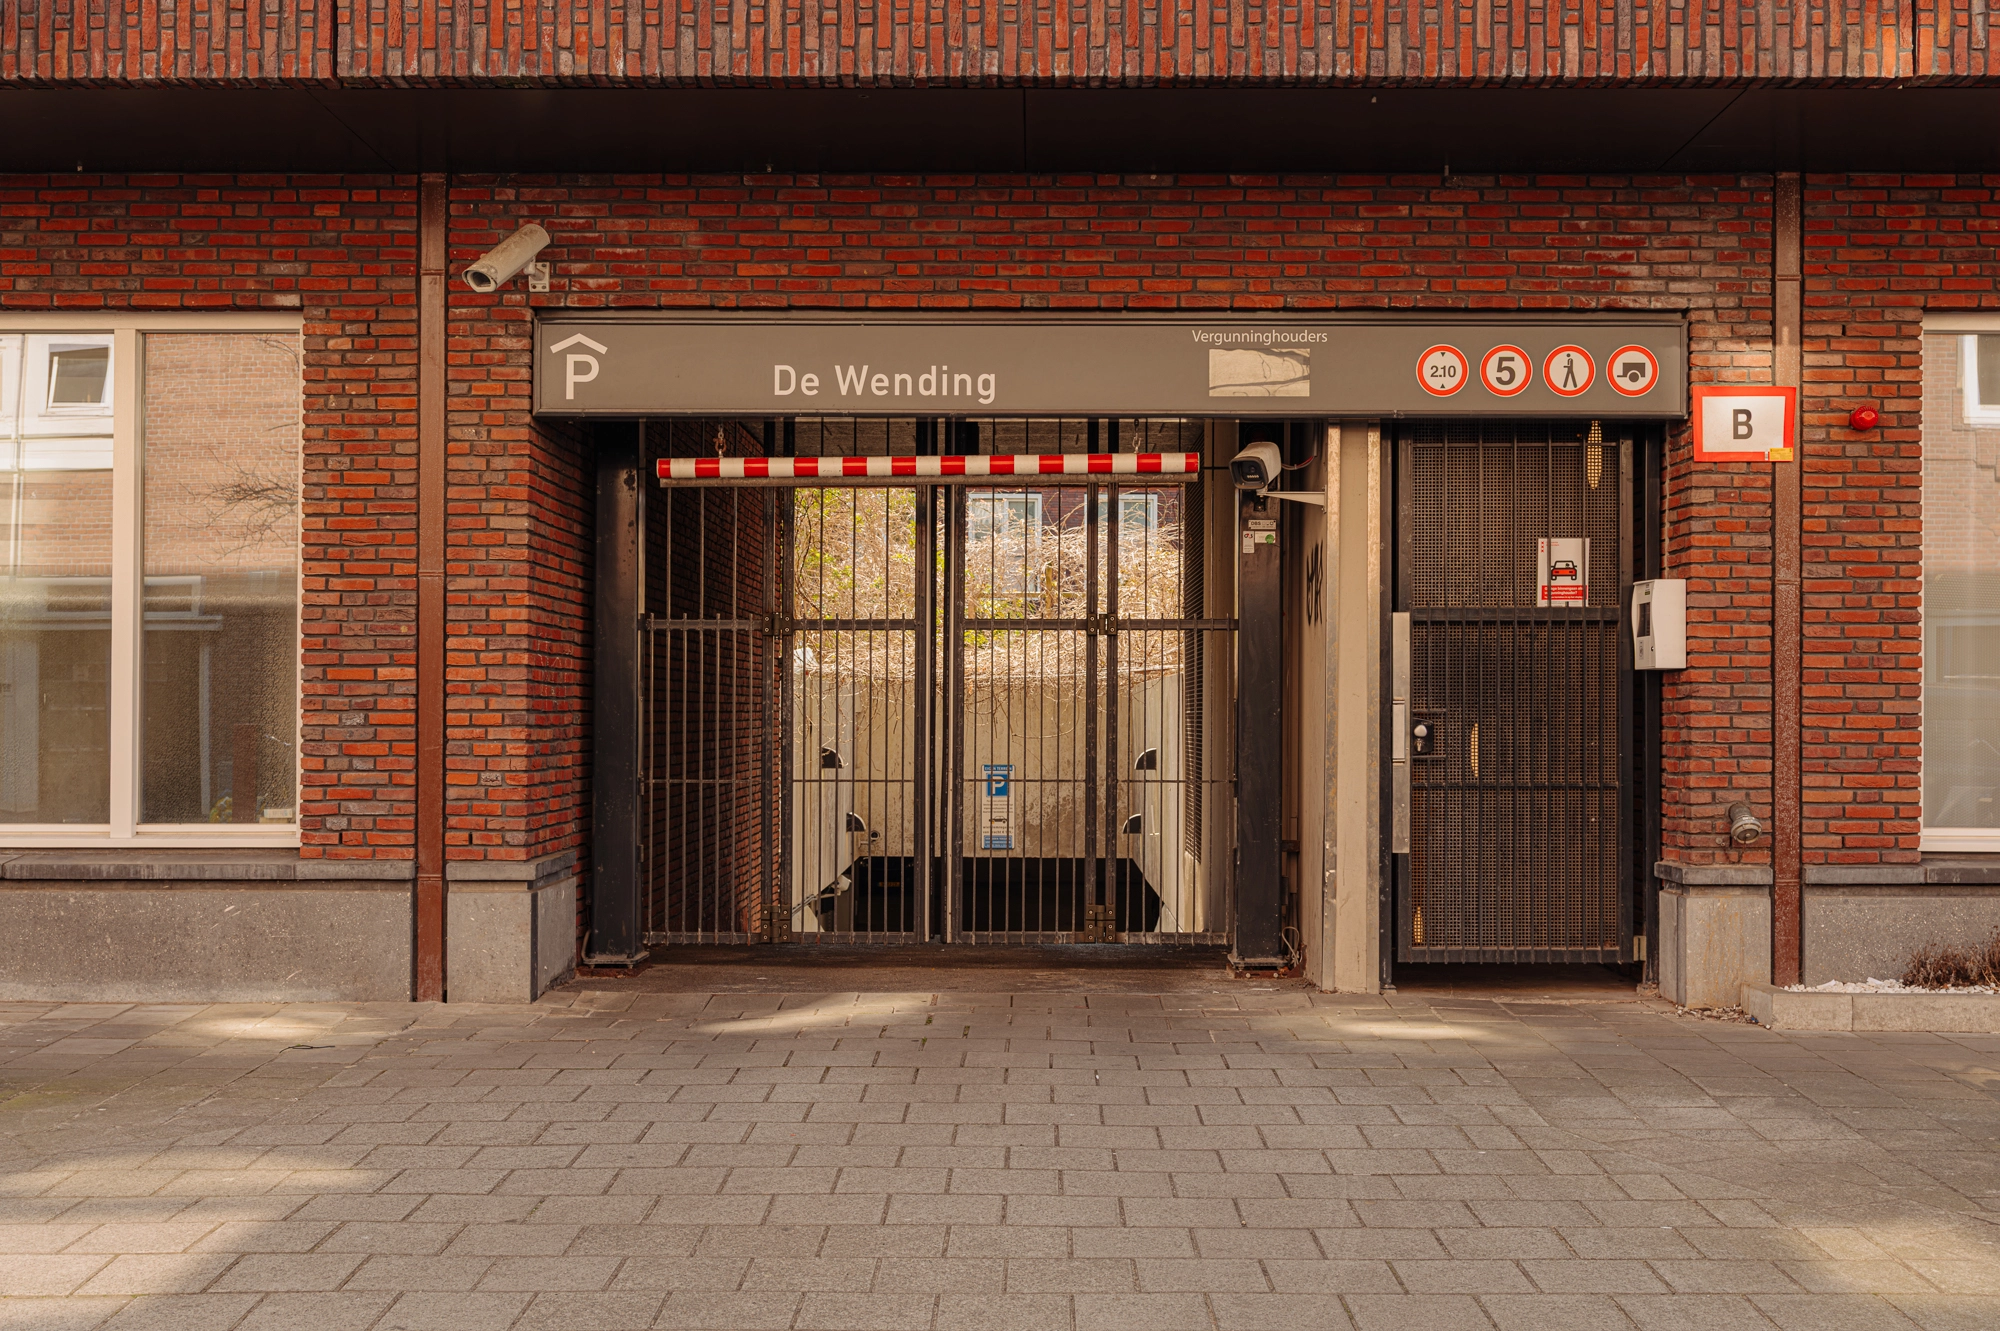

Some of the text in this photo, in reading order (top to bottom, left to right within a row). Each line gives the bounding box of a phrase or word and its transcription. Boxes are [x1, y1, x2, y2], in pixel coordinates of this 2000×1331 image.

[1192, 330, 1328, 345] Vergunninghouders
[566, 354, 599, 399] P
[774, 365, 996, 404] De Wending
[1430, 365, 1456, 378] 2.10
[1496, 357, 1516, 385] 5
[1733, 409, 1753, 439] B
[992, 776, 1005, 794] P
